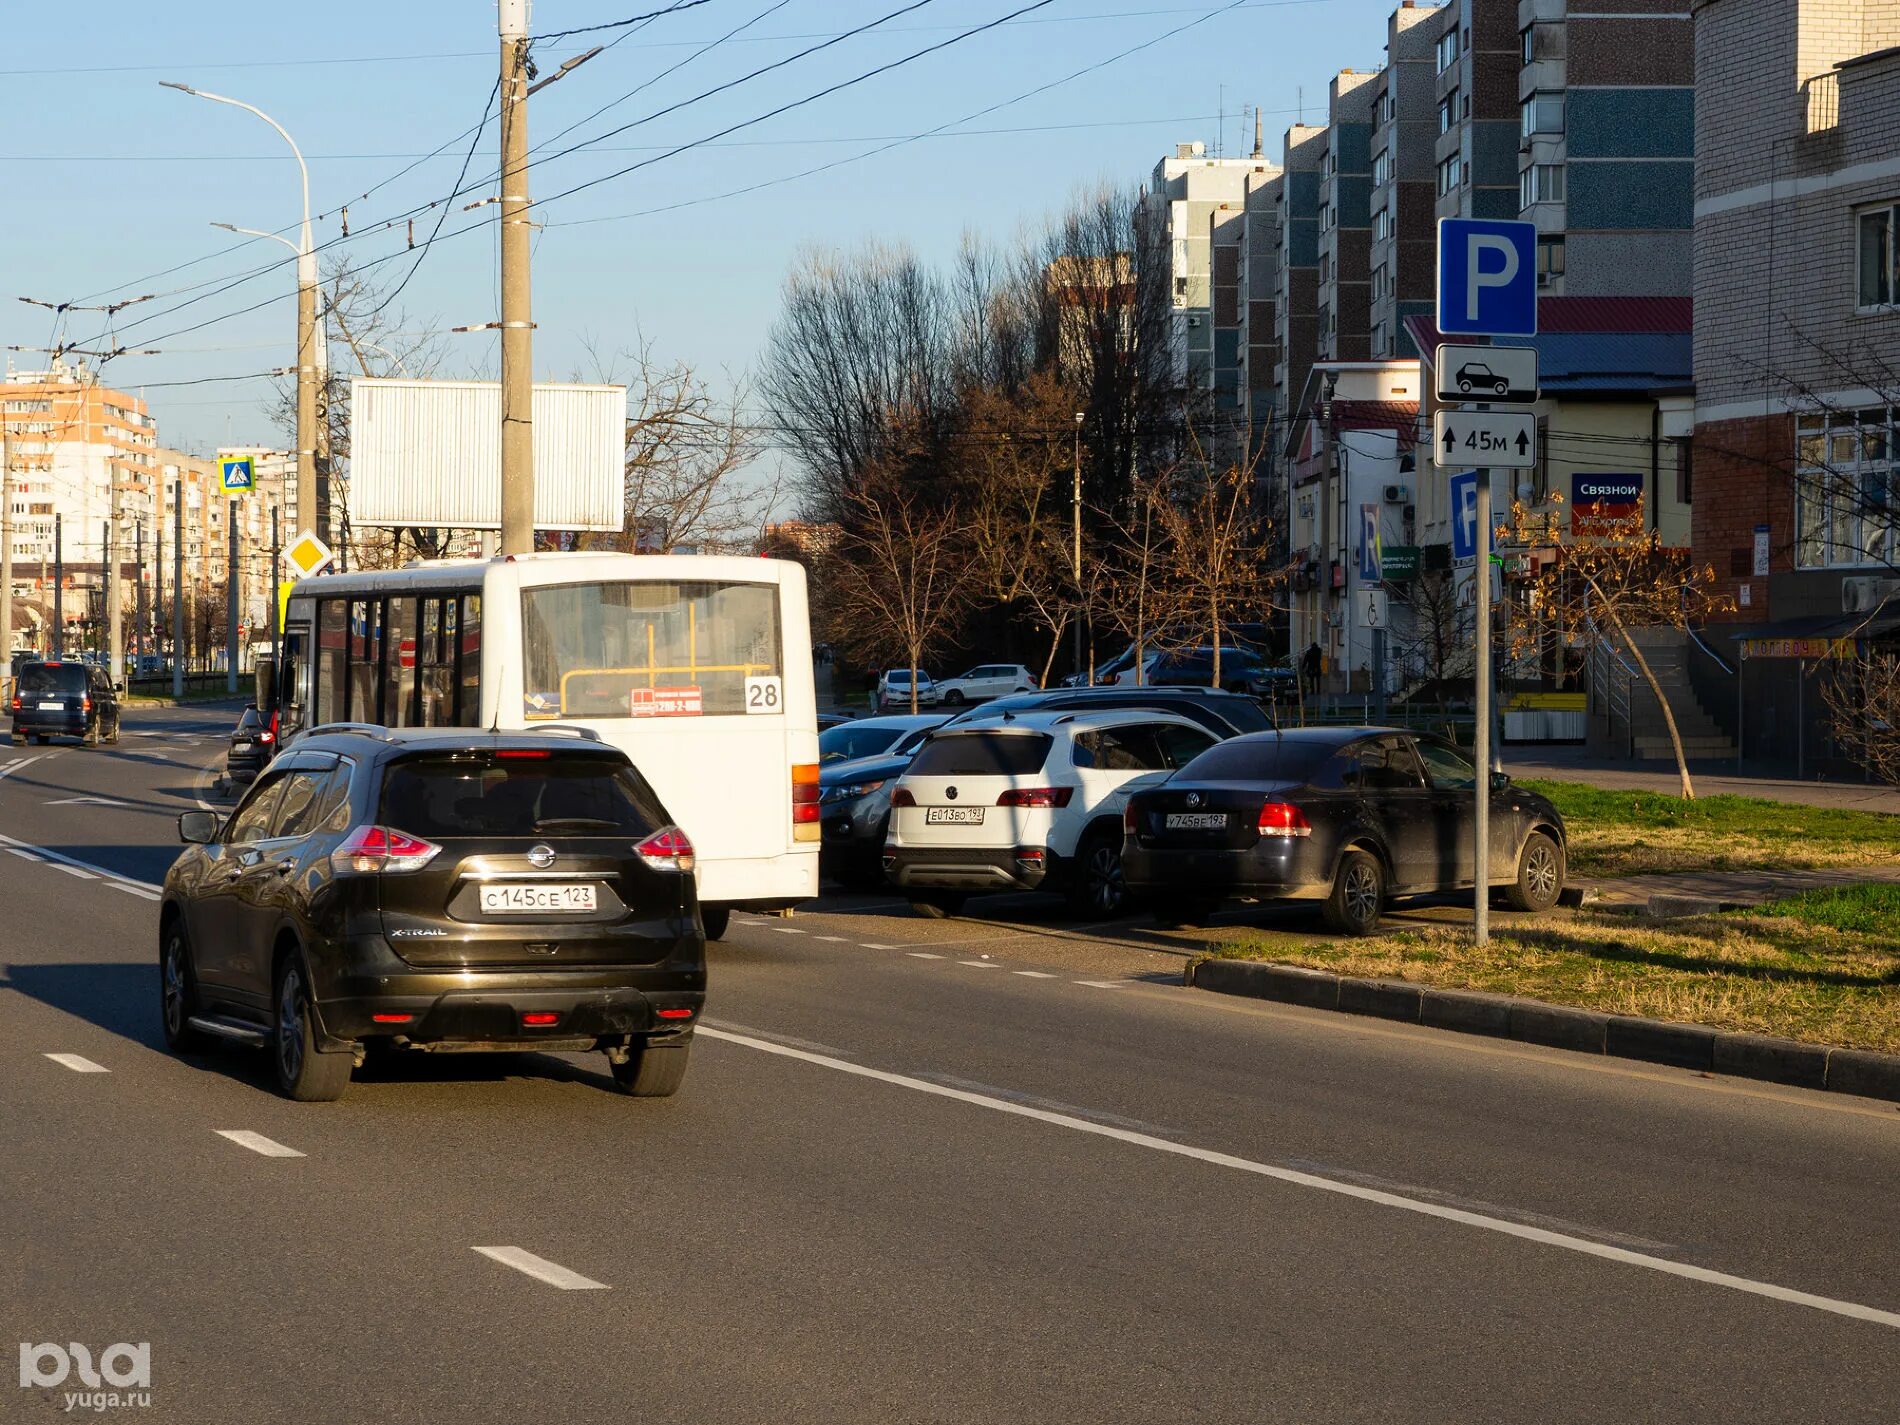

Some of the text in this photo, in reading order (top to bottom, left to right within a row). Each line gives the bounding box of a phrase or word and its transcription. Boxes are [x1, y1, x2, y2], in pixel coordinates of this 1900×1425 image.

[1466, 233, 1520, 321] P
[749, 684, 778, 707] 28
[391, 928, 448, 937] X-TRAIL
